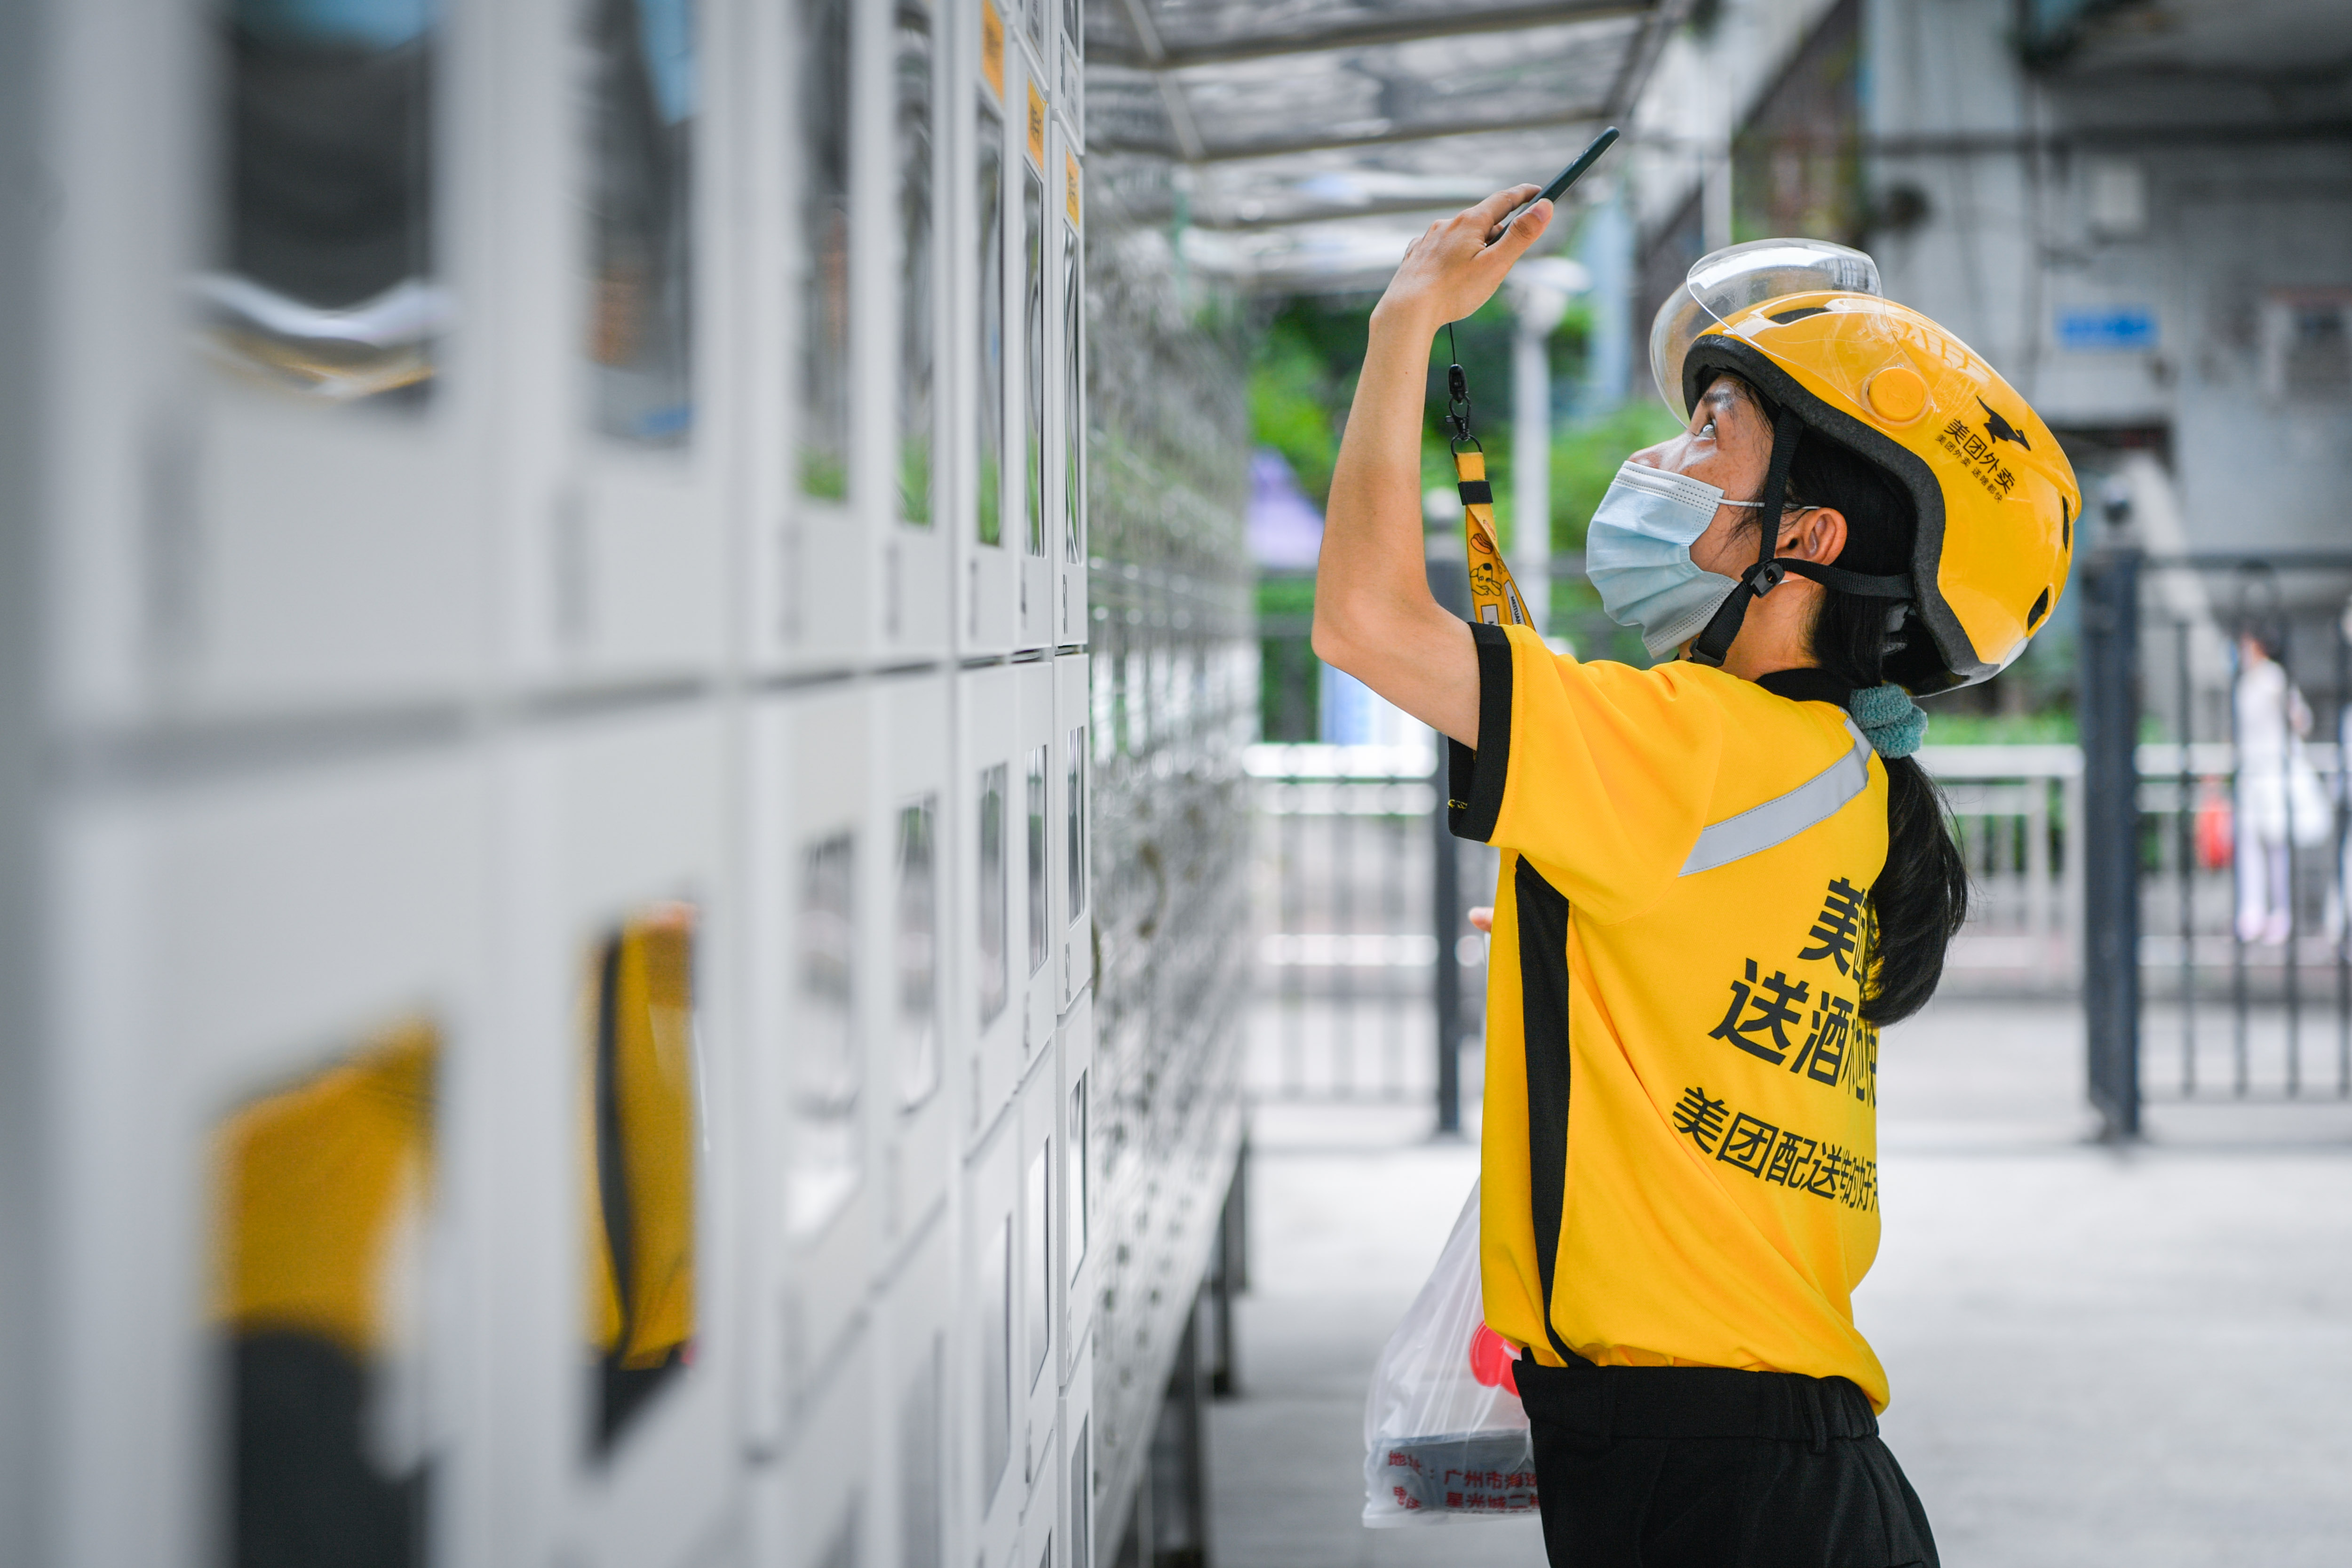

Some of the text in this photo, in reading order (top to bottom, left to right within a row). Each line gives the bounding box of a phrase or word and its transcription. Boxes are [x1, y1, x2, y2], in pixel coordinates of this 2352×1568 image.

[1935, 434, 2003, 504] 美团外卖 送啥都快
[1944, 418, 2015, 494] 美团外卖
[1510, 596, 1522, 624] MEITUAN
